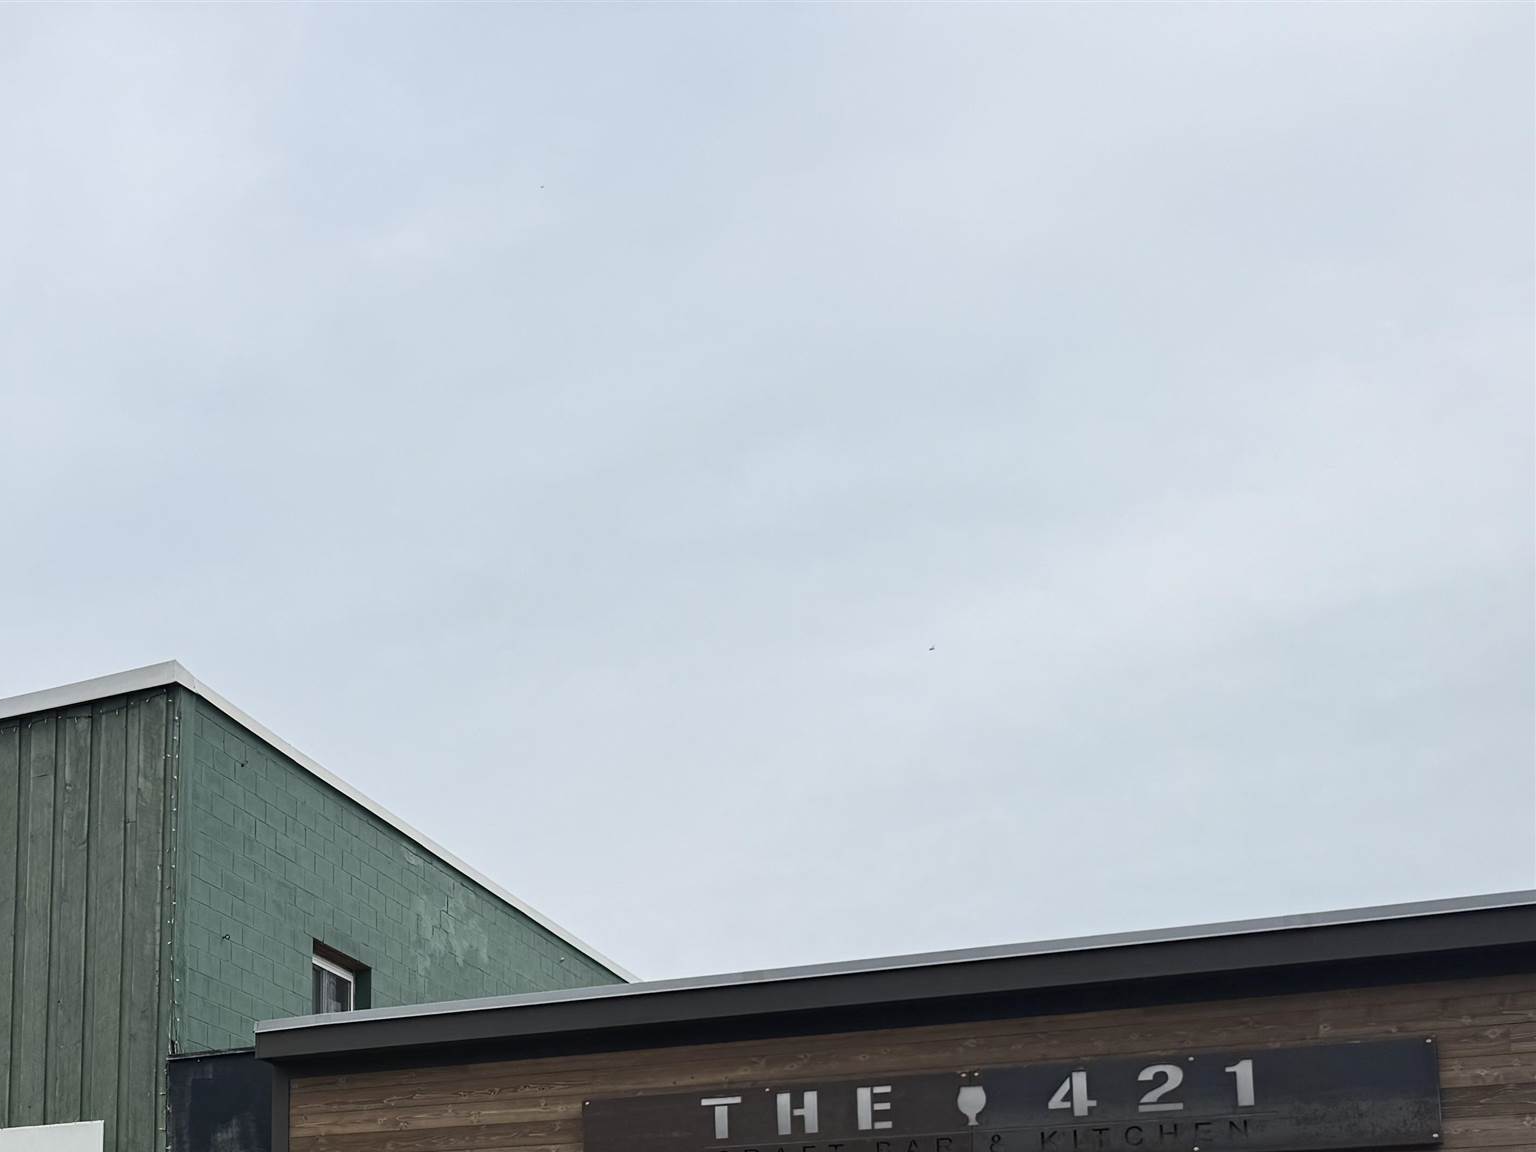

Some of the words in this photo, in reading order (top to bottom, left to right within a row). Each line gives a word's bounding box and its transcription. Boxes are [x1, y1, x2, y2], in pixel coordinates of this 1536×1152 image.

[700, 1085, 893, 1140] THE
[1047, 1059, 1255, 1117] 421
[1039, 1119, 1249, 1151] KITCHEN
